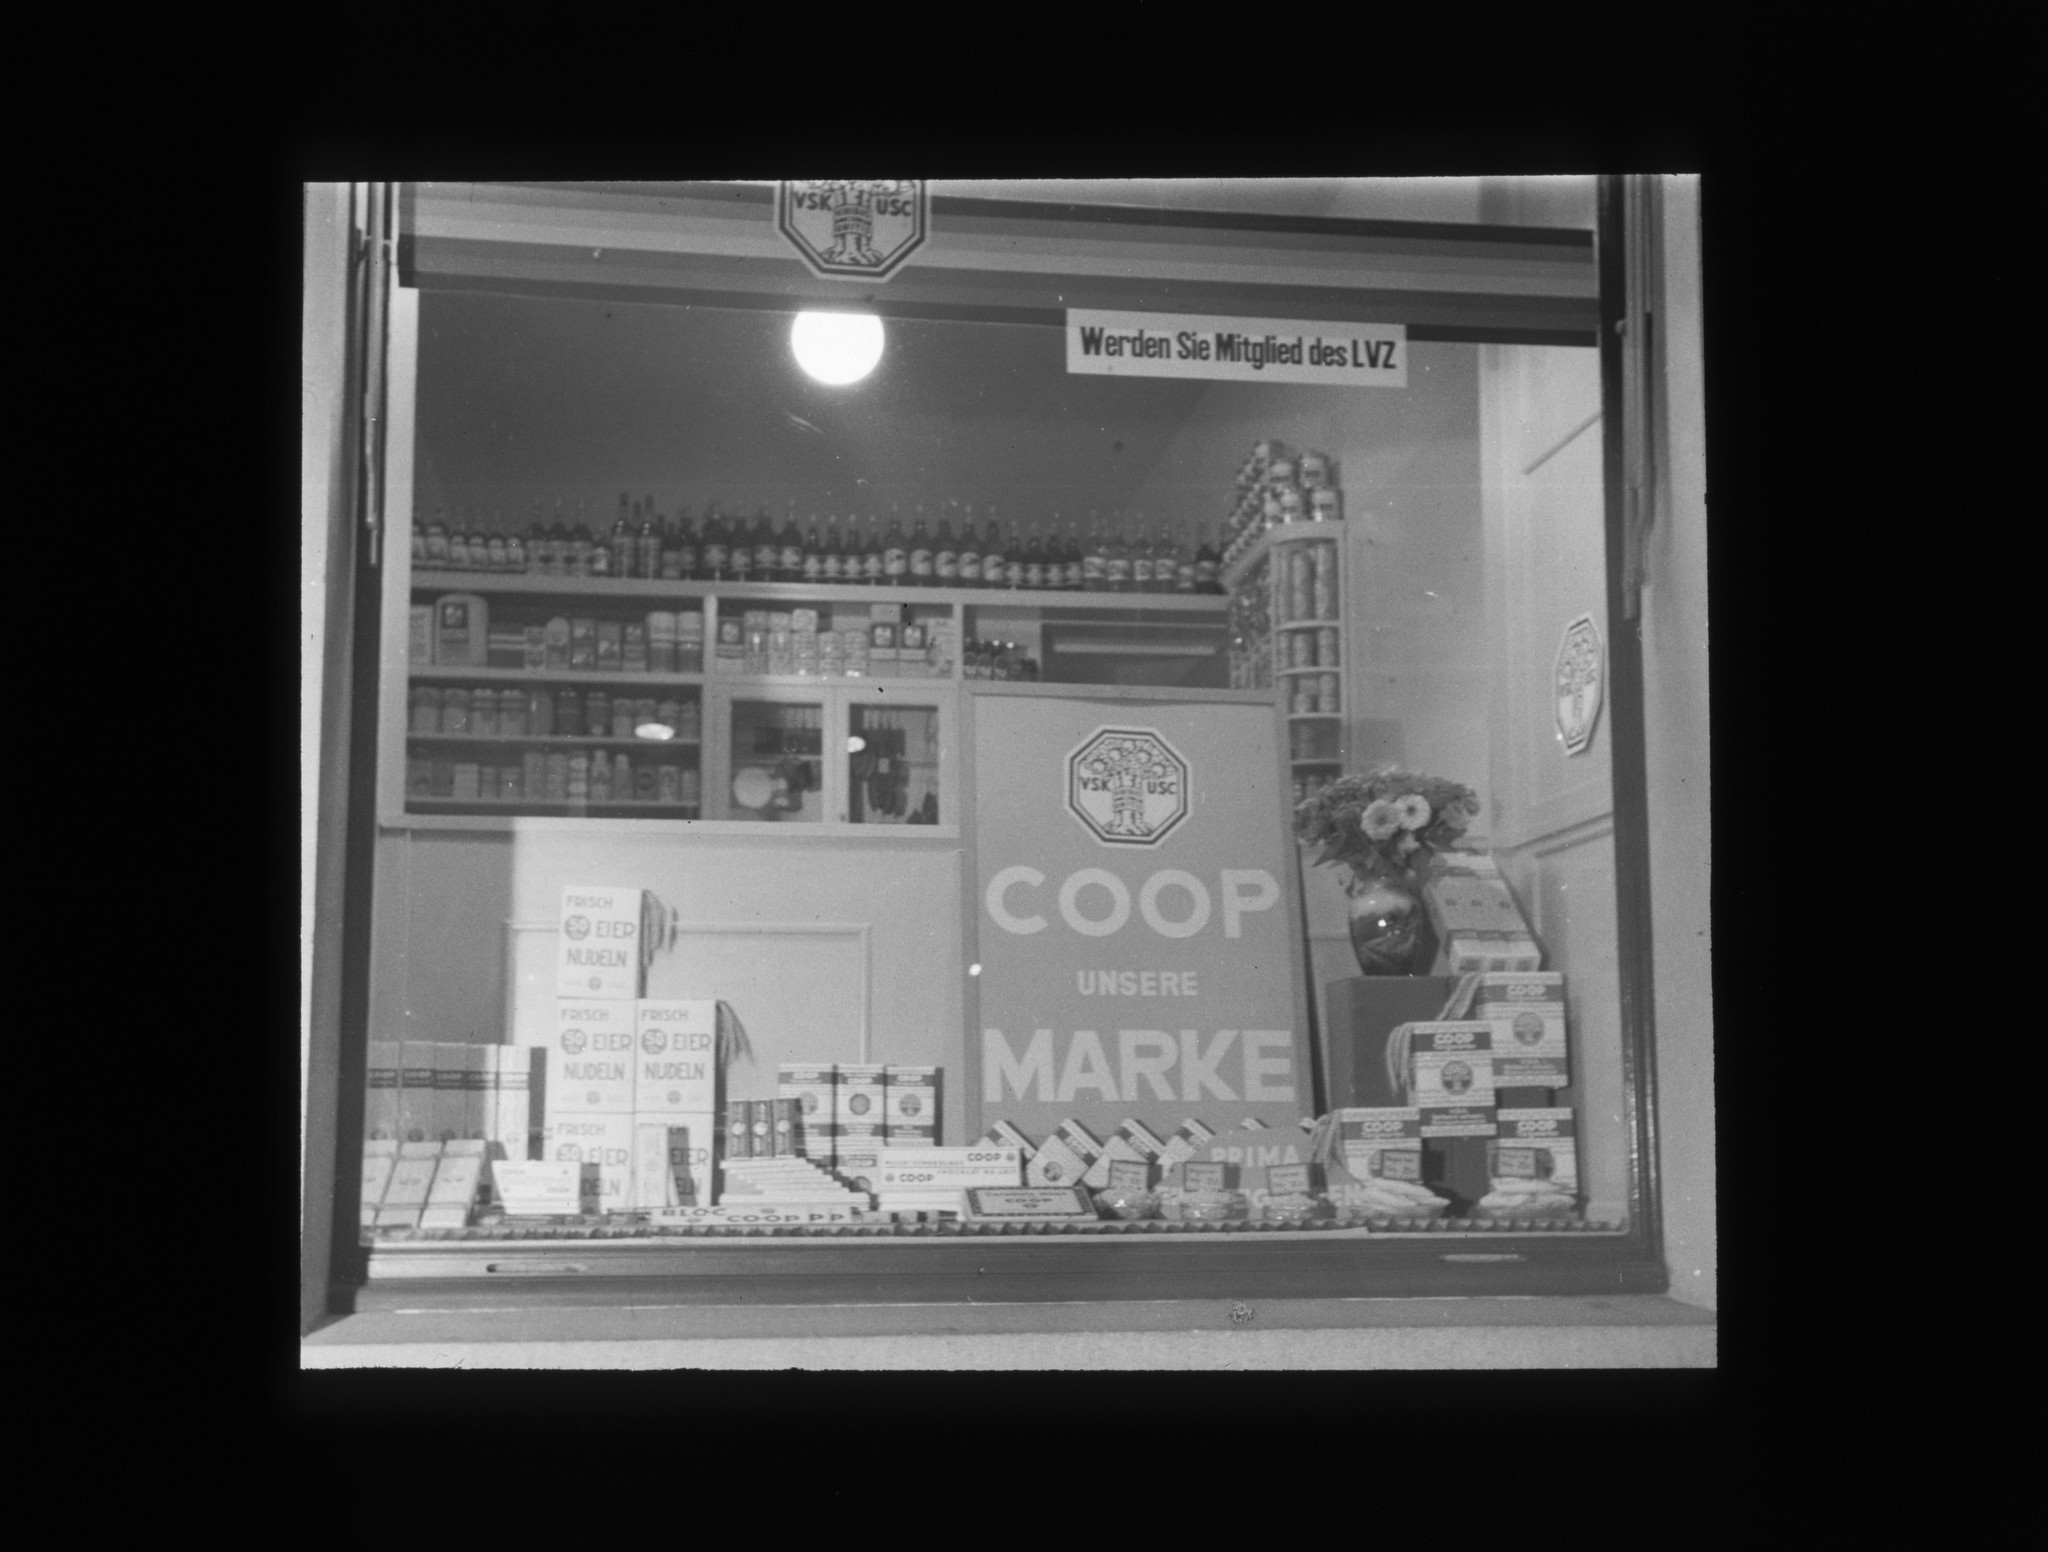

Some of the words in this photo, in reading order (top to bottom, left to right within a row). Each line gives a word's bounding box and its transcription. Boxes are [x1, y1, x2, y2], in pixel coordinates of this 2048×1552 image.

[794, 191, 833, 211] VSK
[876, 198, 913, 217] USC
[1080, 326, 1171, 359] Werden
[1176, 331, 1211, 361] Sie
[1215, 333, 1303, 370] Mitglied
[1309, 337, 1348, 367] des
[1352, 339, 1397, 369] LVZ
[1080, 776, 1111, 792] VSK
[1146, 781, 1177, 795] USC
[565, 895, 613, 909] FRISCH
[985, 865, 1281, 939] COOP
[596, 919, 636, 938] EIER
[566, 948, 627, 967] NUDELN
[1077, 970, 1199, 997] UNSERE
[560, 1008, 609, 1021] FRISCH
[640, 1008, 689, 1022] FRISCH
[592, 1032, 632, 1051] EIER
[672, 1032, 712, 1051] EIER
[564, 1062, 625, 1081] NUDELN
[644, 1062, 705, 1081] NUDELN
[982, 1028, 1296, 1102] MARKE
[556, 1122, 605, 1136] FRISCH
[589, 1149, 628, 1167] EIER
[669, 1147, 709, 1165] EIER
[662, 1208, 726, 1218] BLOC
